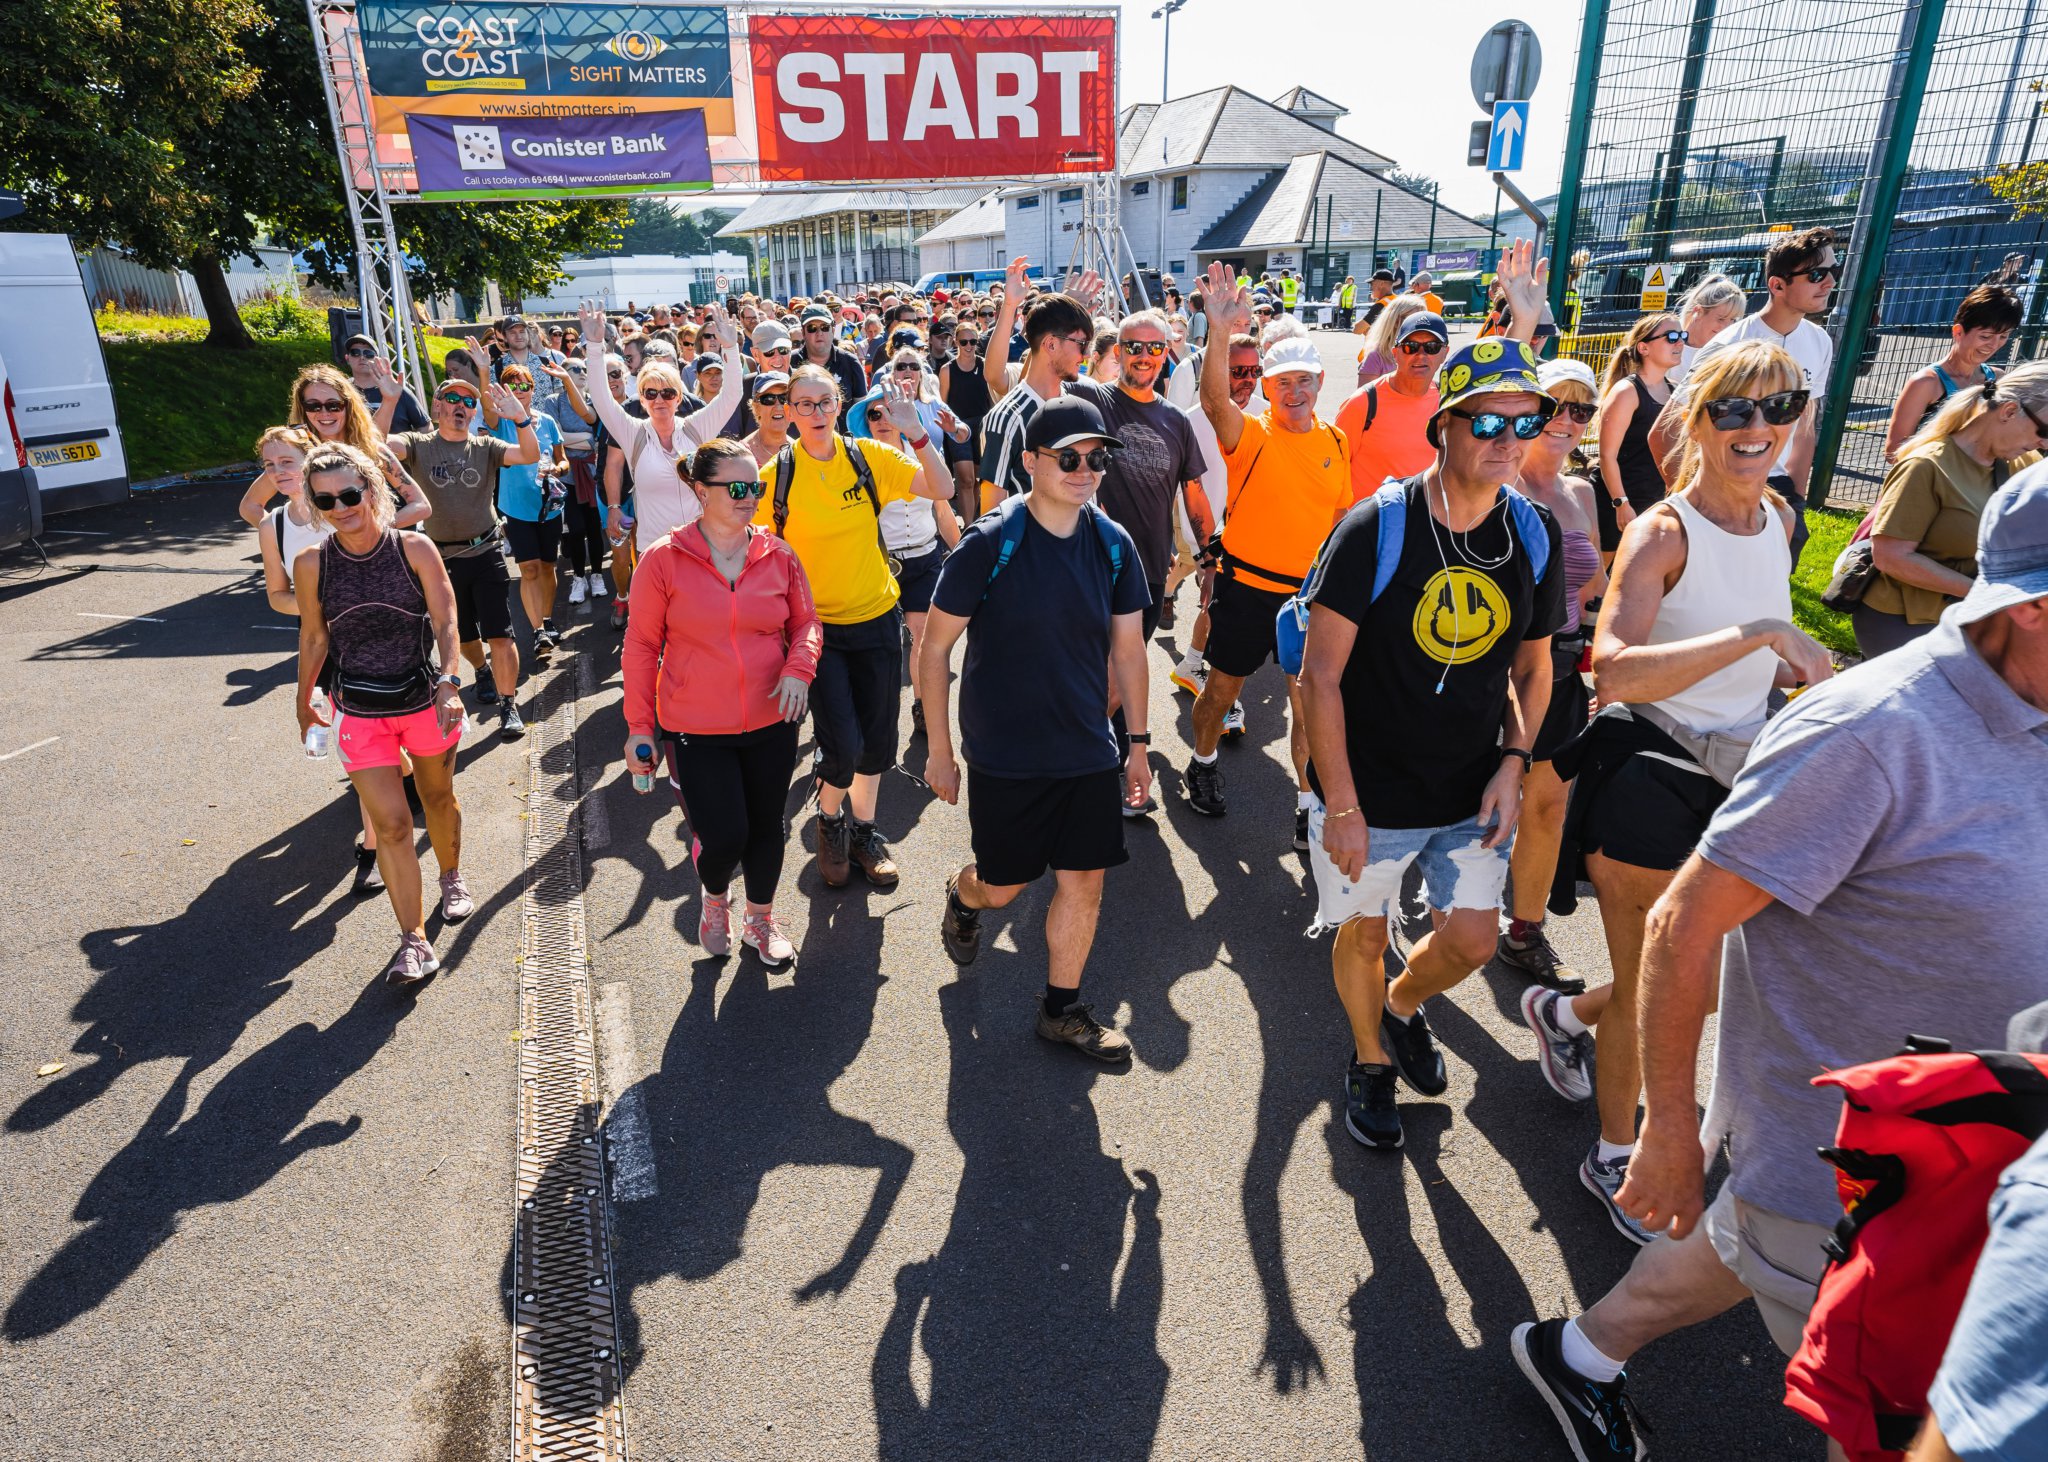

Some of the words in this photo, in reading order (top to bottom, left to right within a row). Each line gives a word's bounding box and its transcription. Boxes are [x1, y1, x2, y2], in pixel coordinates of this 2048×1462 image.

[416, 16, 519, 46] COAST
[455, 29, 479, 58] 2
[422, 49, 522, 77] COAST
[570, 66, 622, 82] SIGHT
[629, 66, 707, 83] MATTERS
[776, 51, 1099, 143] START
[511, 137, 606, 157] Conister
[611, 133, 667, 155] Bank
[464, 176, 480, 185] Call
[482, 177, 491, 185] us
[492, 176, 517, 186] today
[531, 175, 564, 184] 694694
[569, 170, 671, 184] www.conisterbank.co.im
[1436, 257, 1456, 265] Conister
[1456, 255, 1469, 264] Bank
[25, 402, 81, 413] DUCATO
[33, 449, 62, 465] RMN
[60, 446, 84, 460] 667
[86, 444, 97, 458] D
